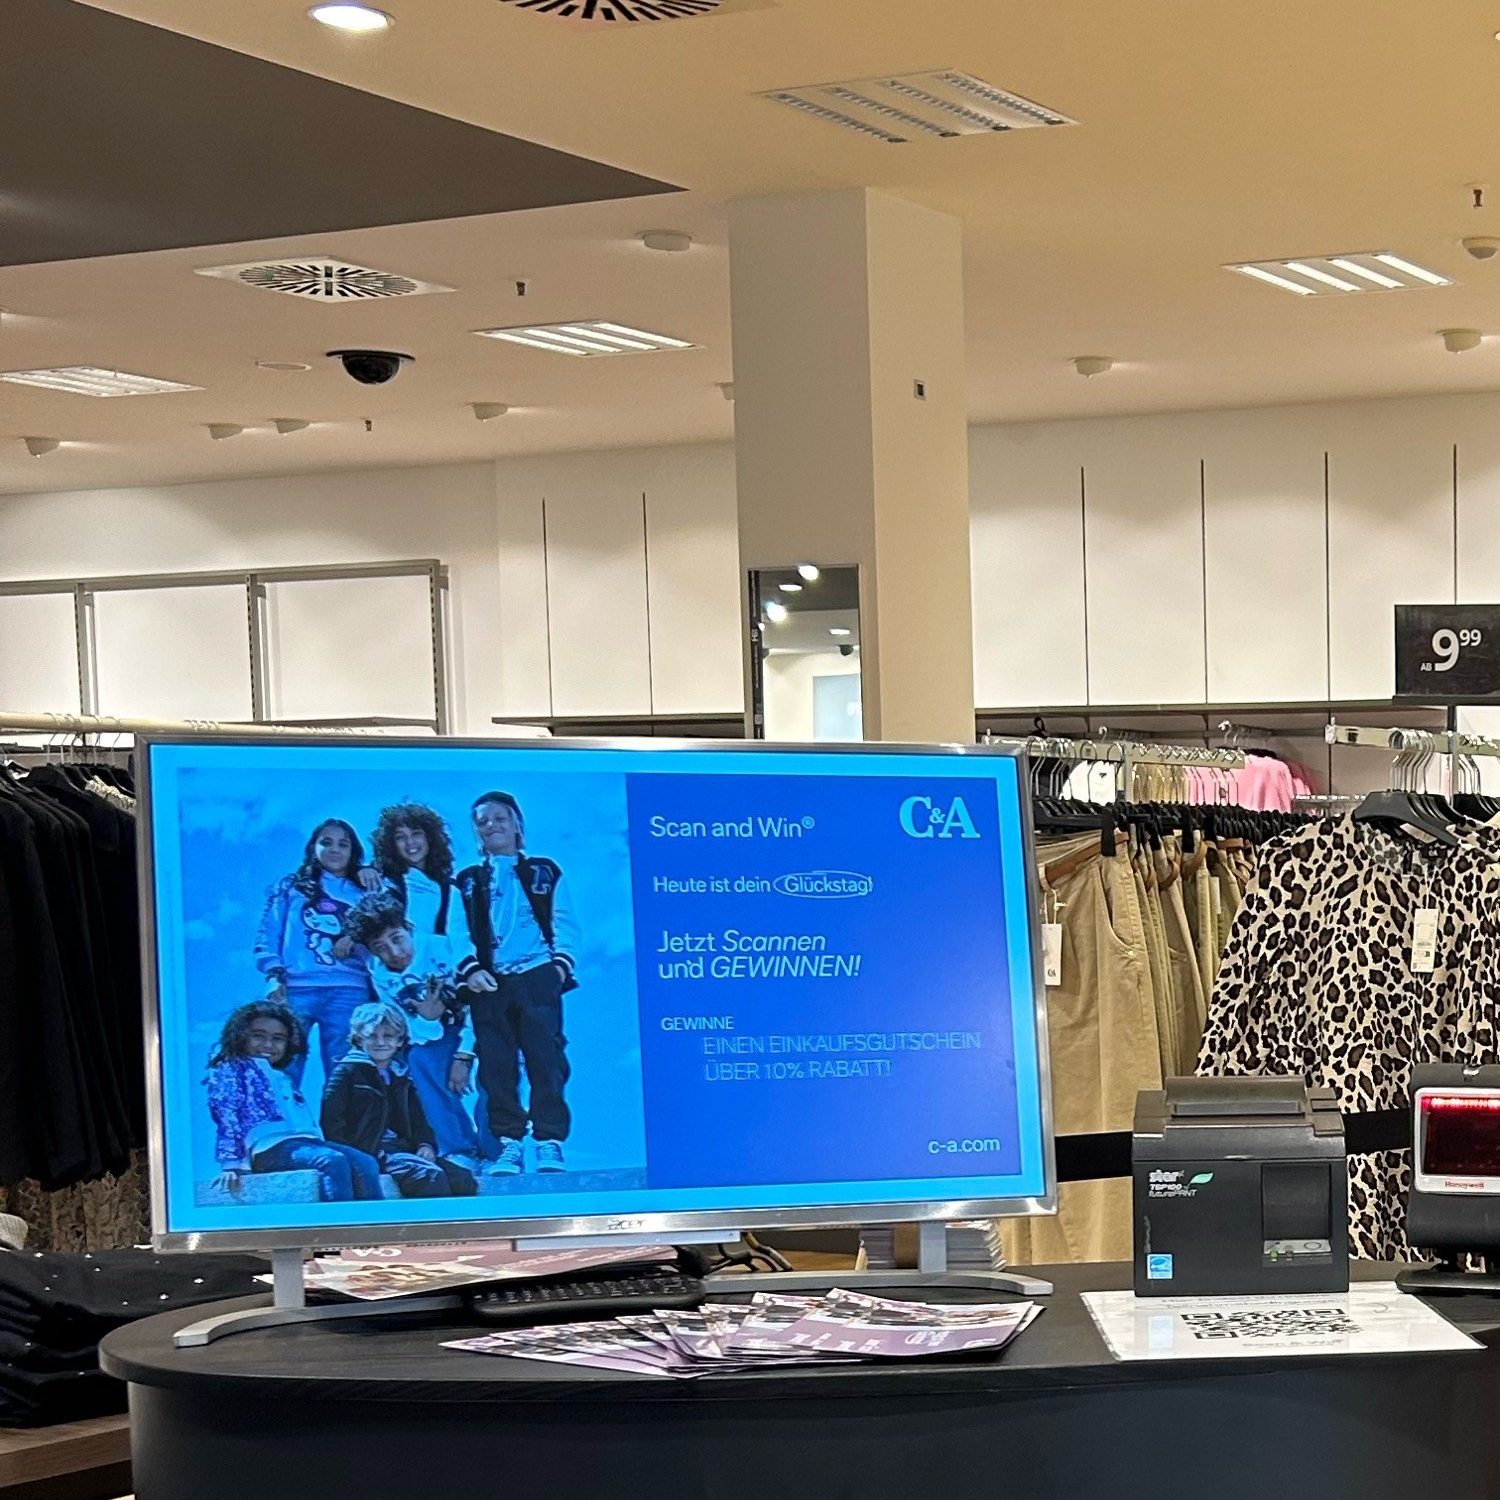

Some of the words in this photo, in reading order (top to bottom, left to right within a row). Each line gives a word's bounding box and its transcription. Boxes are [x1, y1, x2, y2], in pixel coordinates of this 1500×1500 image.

[1420, 663, 1432, 671] AB
[650, 816, 707, 838] Scan
[711, 817, 753, 838] and
[900, 795, 981, 838] C&A
[653, 876, 707, 892] Heute
[710, 876, 731, 892] ist
[733, 876, 771, 892] dein
[657, 931, 716, 952] Jetzt
[721, 930, 826, 951] Scannen
[658, 957, 703, 978] und
[710, 955, 861, 977] GEWINNEN!
[661, 1016, 735, 1031] GEWINNE
[703, 1036, 765, 1055] EINEN
[769, 1032, 982, 1053] EINKAUFSGUTSCHEIN
[704, 1059, 761, 1081] ÜBER
[764, 1062, 805, 1080] 10%
[808, 1059, 892, 1078] RABATT!
[928, 1138, 1001, 1154] c-a.com
